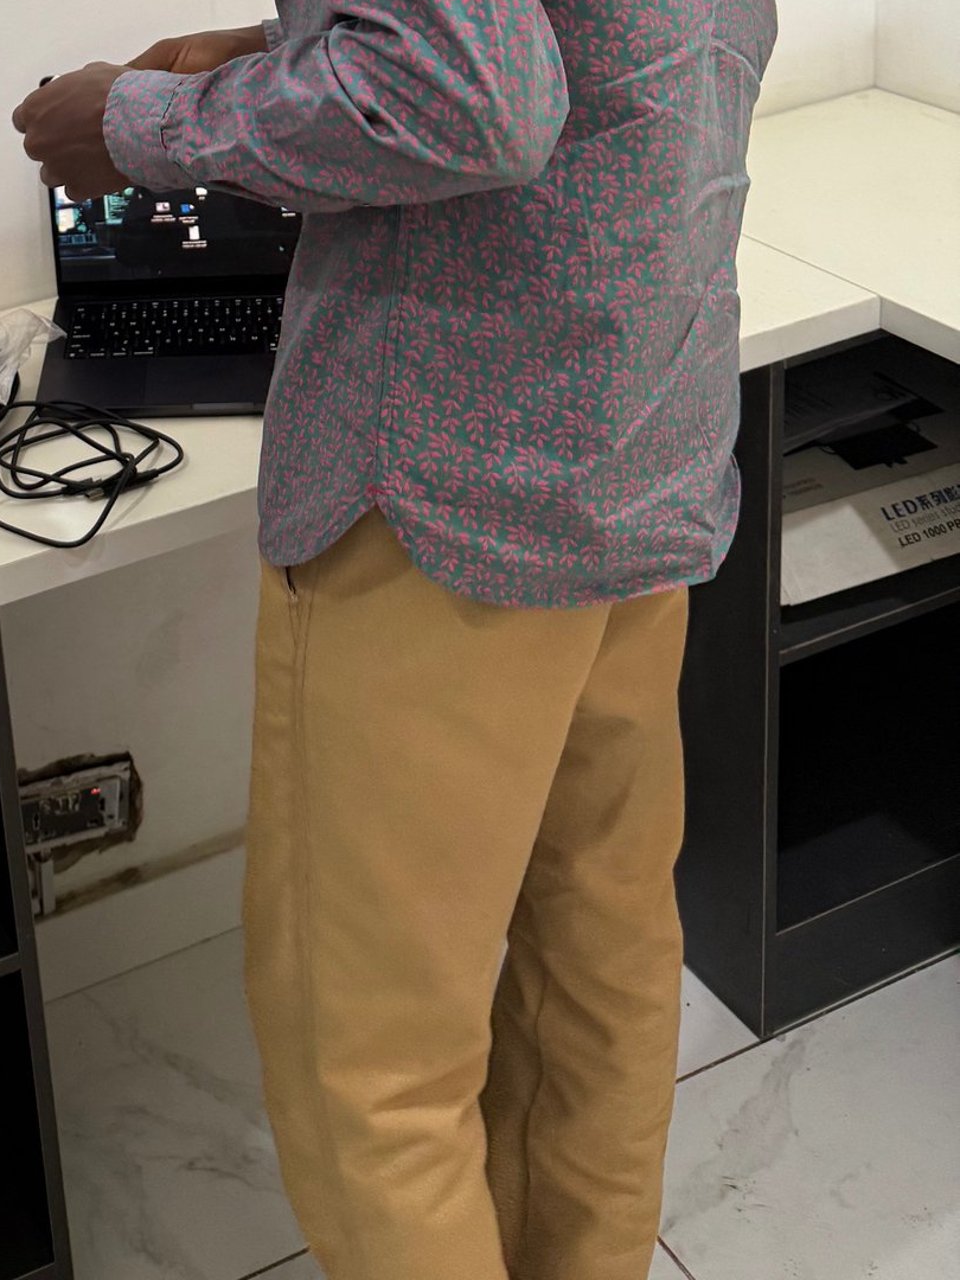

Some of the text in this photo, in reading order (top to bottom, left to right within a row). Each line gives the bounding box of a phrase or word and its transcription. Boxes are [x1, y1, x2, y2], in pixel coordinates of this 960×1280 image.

[881, 484, 960, 521] LED系列影
[898, 532, 921, 548] LED
[923, 523, 947, 539] 1000
